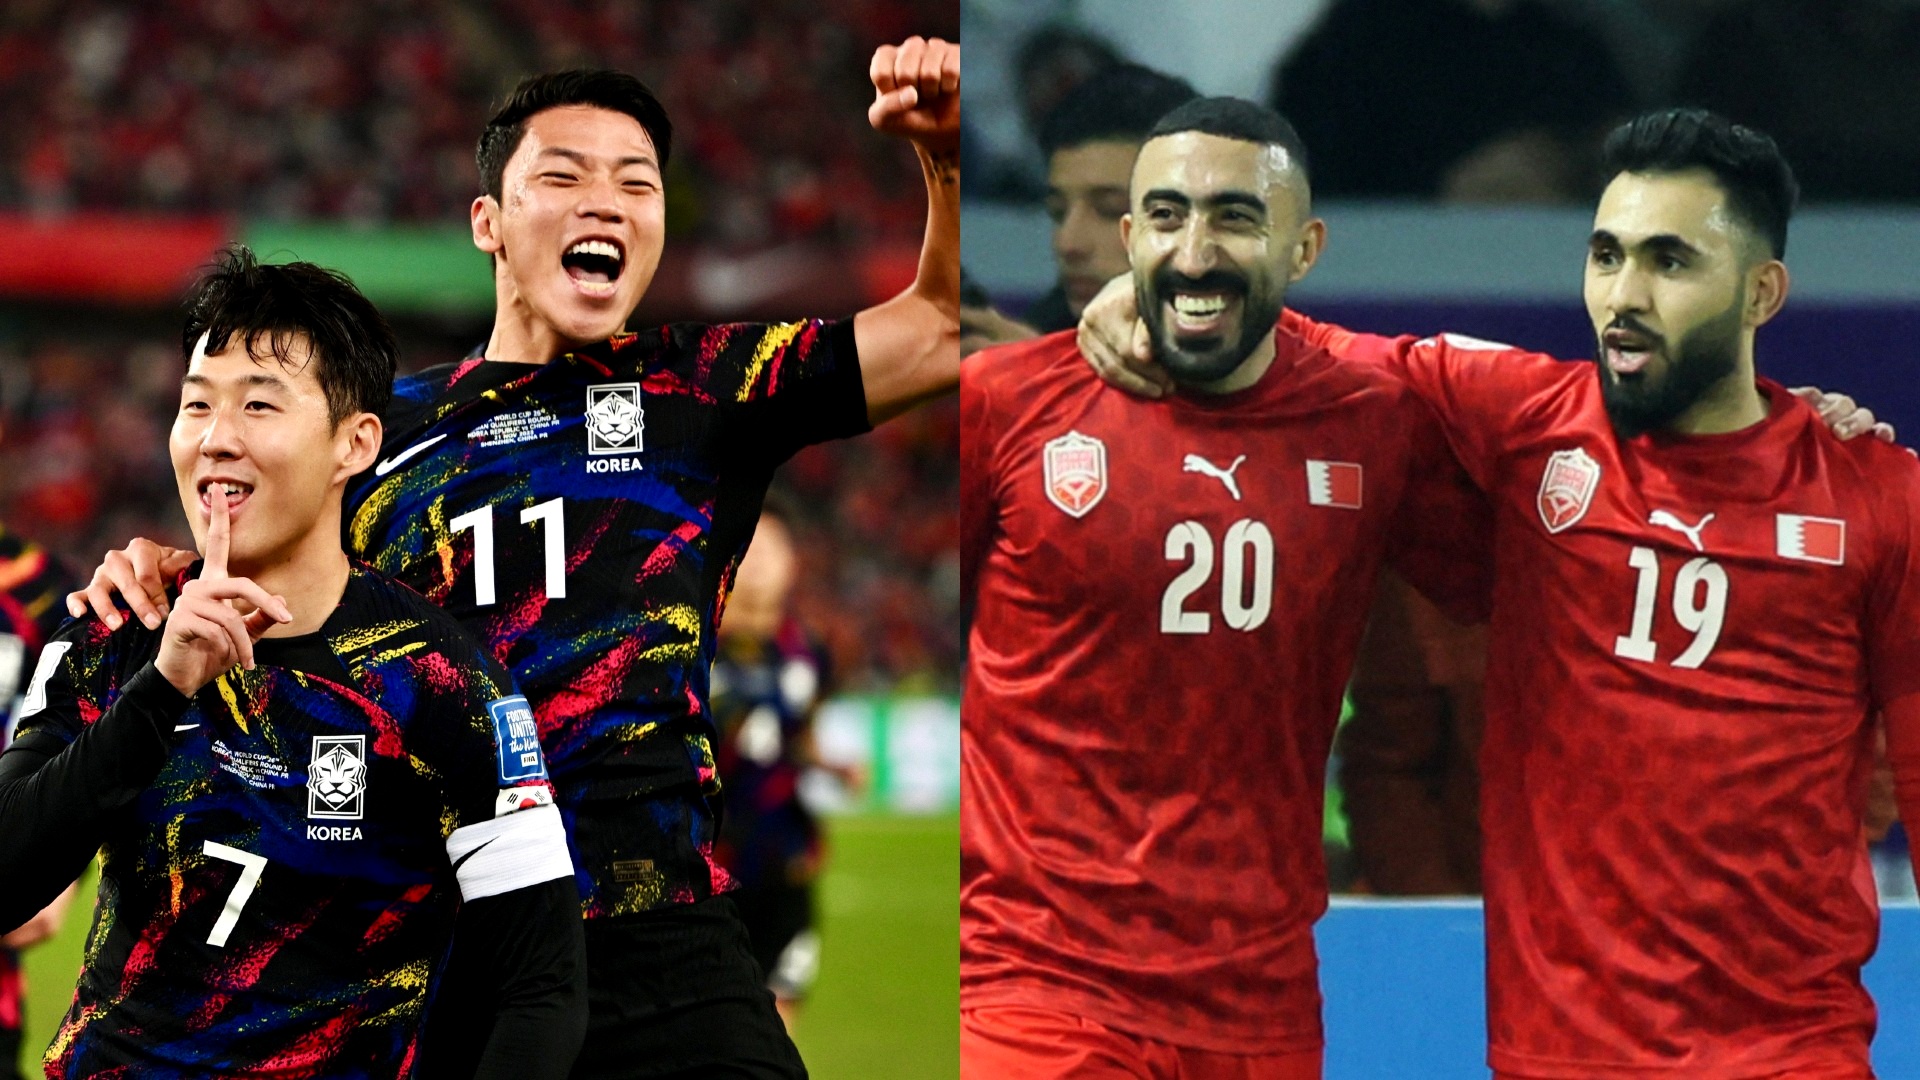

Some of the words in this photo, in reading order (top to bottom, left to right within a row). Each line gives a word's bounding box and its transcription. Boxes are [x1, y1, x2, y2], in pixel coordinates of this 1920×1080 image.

[494, 413, 517, 421] WORLD
[586, 458, 643, 473] KOREA
[450, 497, 566, 606] 11
[1161, 518, 1274, 633] 20
[1615, 547, 1729, 669] 19
[260, 761, 283, 771] ROUND
[524, 755, 536, 763] FIFA
[261, 769, 279, 777] CHINA
[307, 825, 363, 840] KOREA
[203, 840, 268, 947] 7
